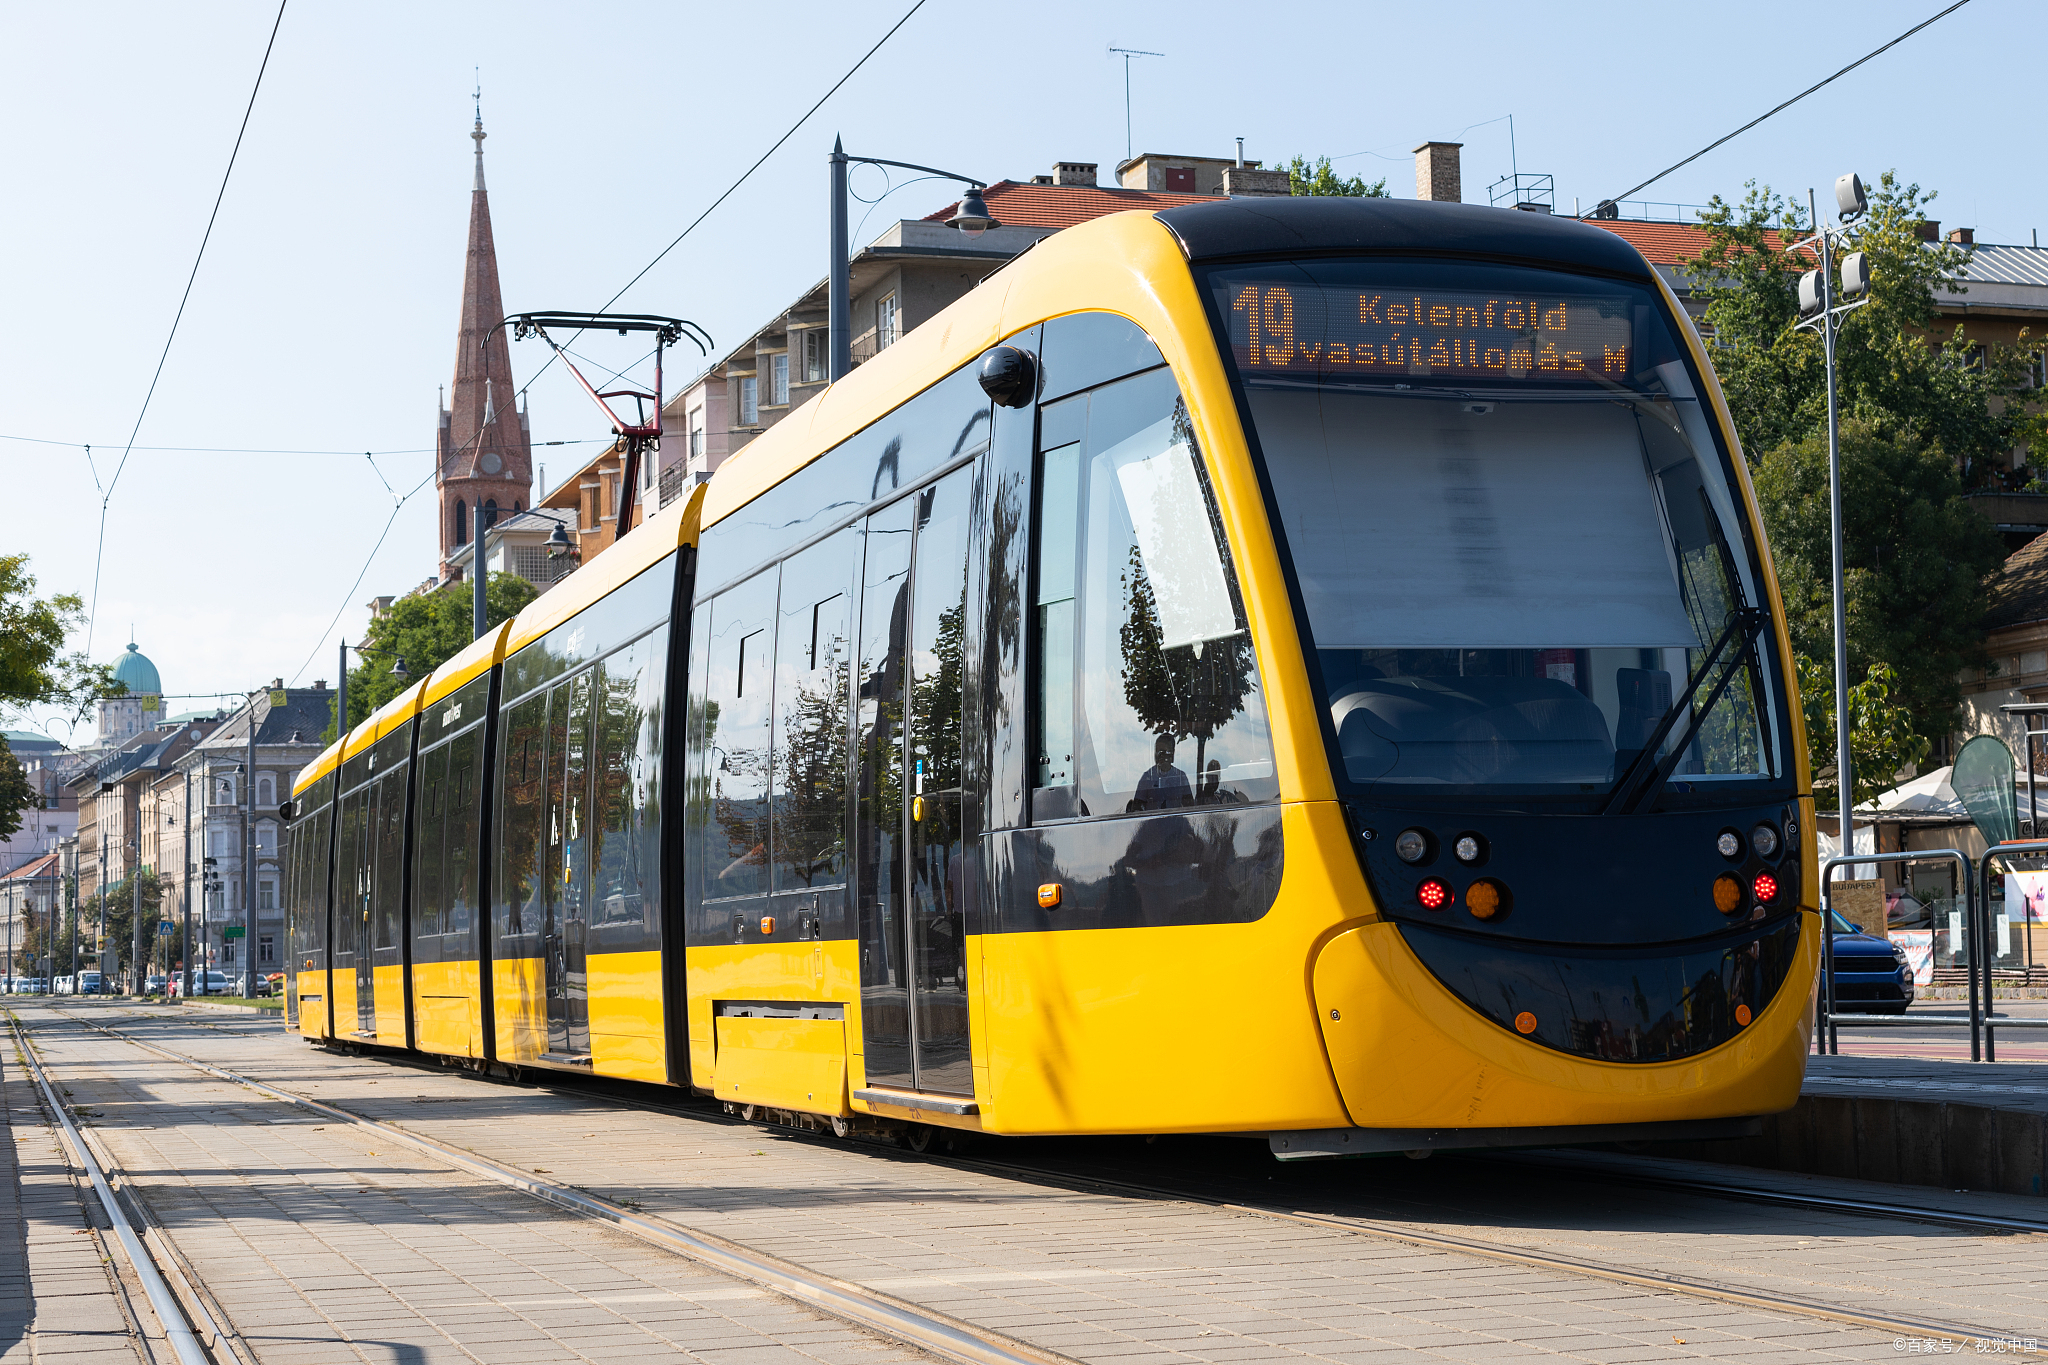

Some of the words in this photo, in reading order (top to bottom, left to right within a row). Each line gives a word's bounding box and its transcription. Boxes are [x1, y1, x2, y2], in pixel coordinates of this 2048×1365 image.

[1233, 286, 1294, 366] 19
[1358, 294, 1567, 331] Kelenföld
[1299, 332, 1585, 372] vasútállomás
[1604, 343, 1626, 372] M
[1832, 881, 1877, 891] BUDAPEST
